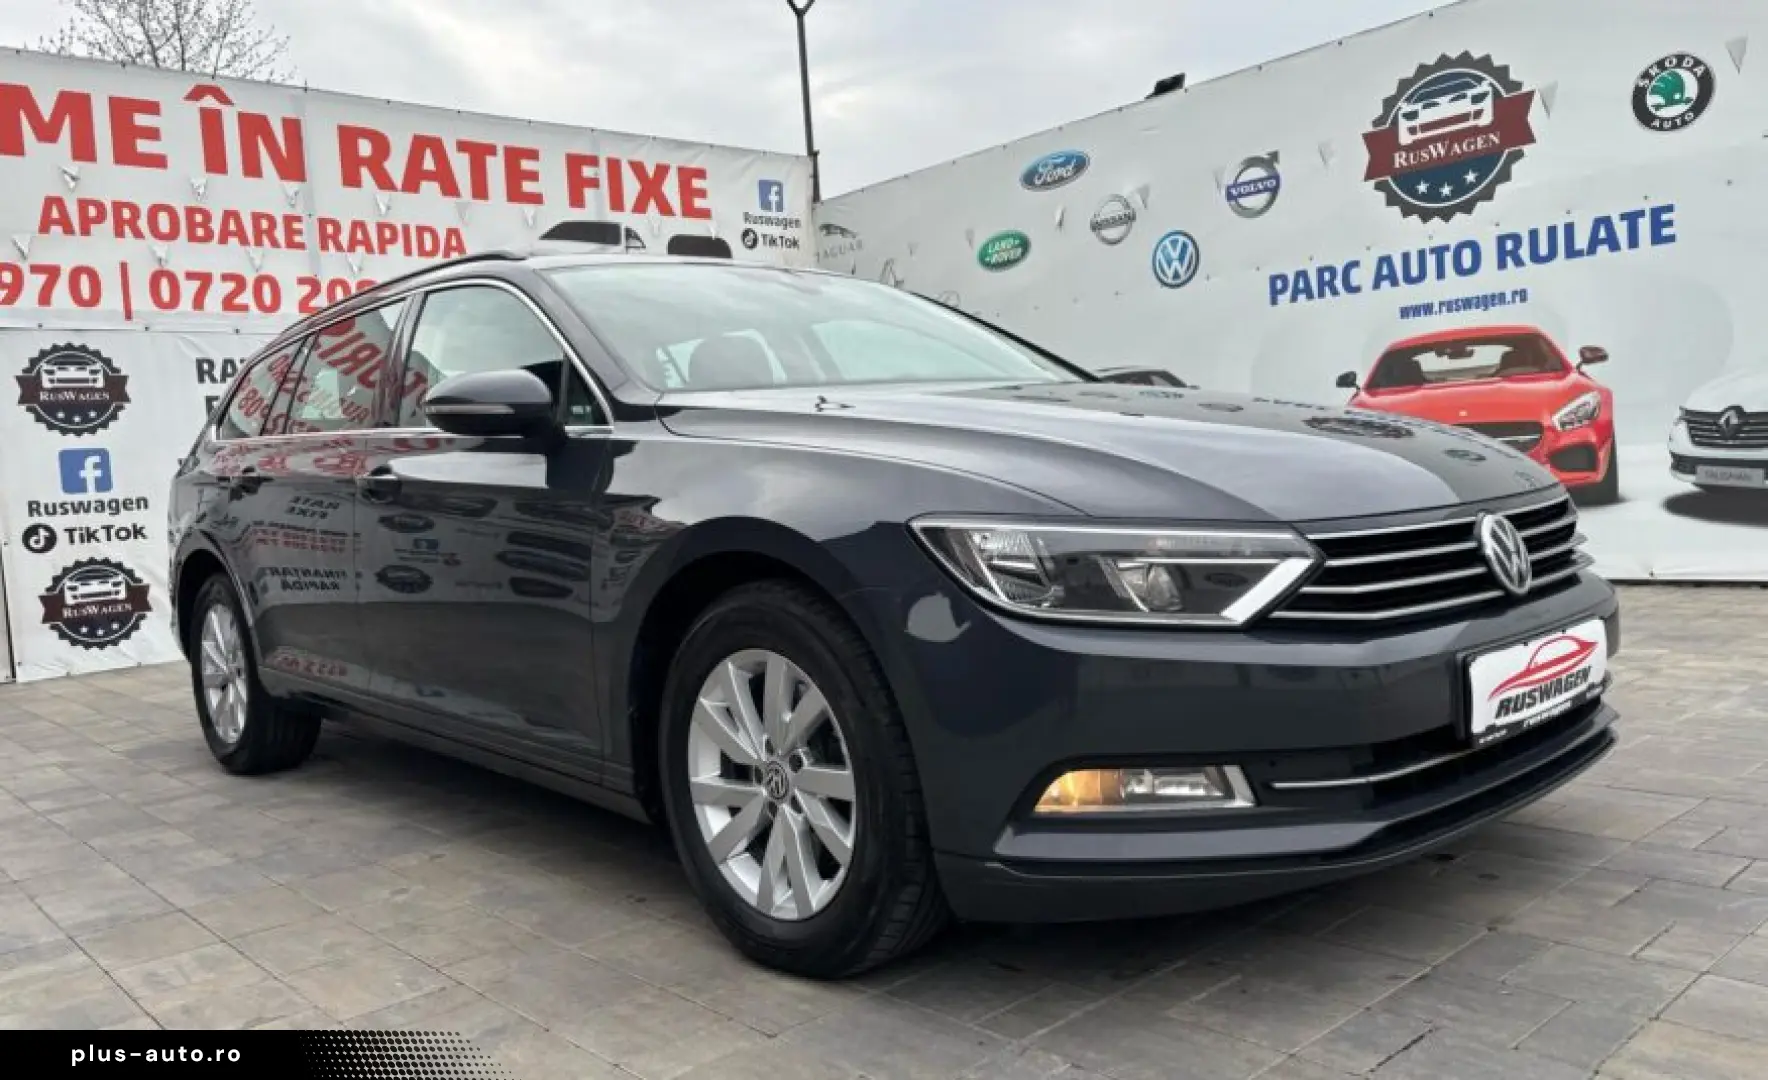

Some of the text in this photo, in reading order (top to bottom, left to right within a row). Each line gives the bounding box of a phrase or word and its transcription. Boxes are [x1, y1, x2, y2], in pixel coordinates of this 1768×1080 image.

[1650, 111, 1695, 129] AUTO
[183, 84, 308, 183] ÎN
[337, 124, 545, 206] RATE
[565, 152, 712, 220] FIXE
[1229, 179, 1277, 197] VOLVO
[38, 195, 468, 258] APROBARE RAPIDA
[743, 211, 801, 231] Ruswagen
[760, 233, 800, 250] TikTok
[1269, 203, 1677, 306] PARC AUTO RULATE
[148, 269, 282, 314] 0720
[296, 276, 378, 314] 20
[1399, 287, 1529, 320] www.ruswagen.ro
[27, 496, 149, 518] Ruswagen
[63, 523, 148, 546] TikTok
[1495, 665, 1592, 720] RUSWAGEN
